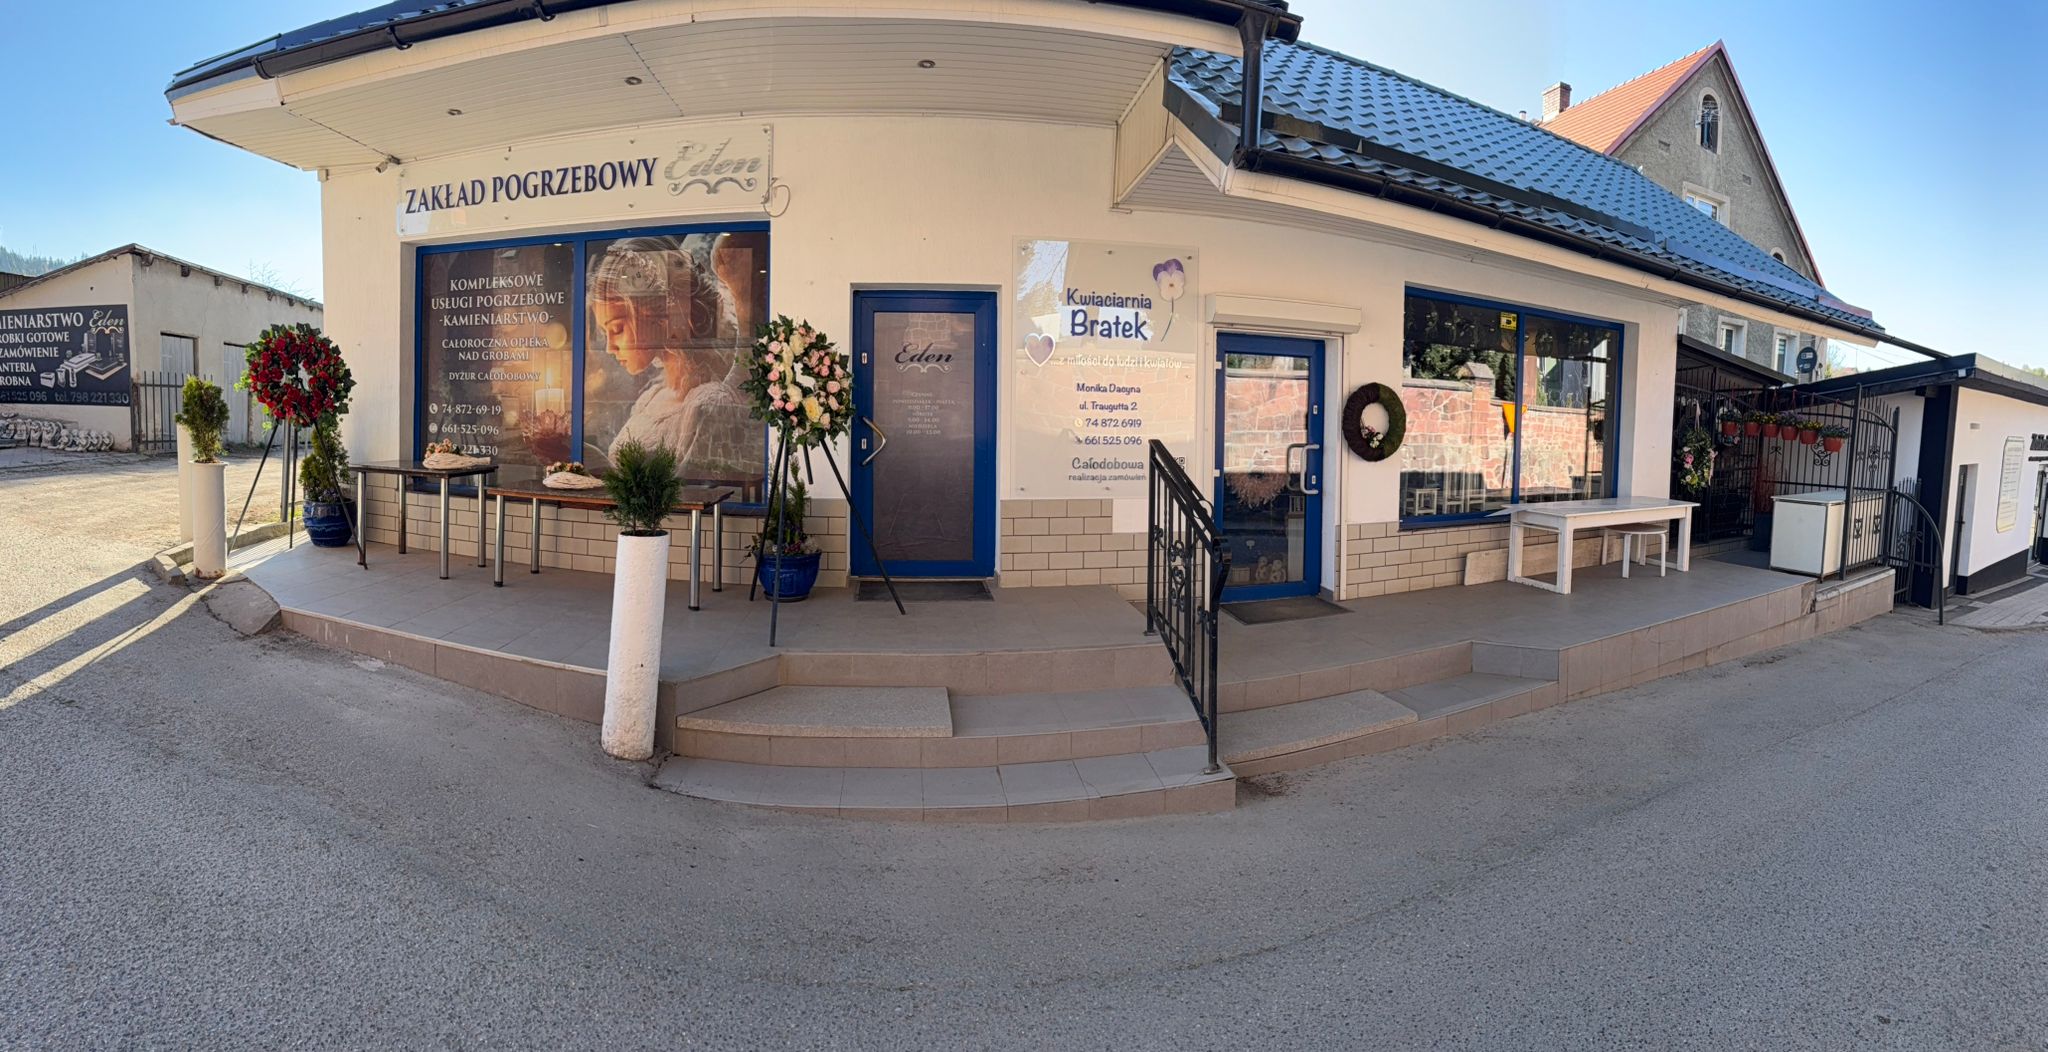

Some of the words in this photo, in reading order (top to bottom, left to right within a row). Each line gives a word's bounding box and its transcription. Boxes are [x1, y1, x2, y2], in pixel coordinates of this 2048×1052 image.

[664, 137, 762, 181] Eden
[405, 179, 485, 214] ZAKŁAD
[492, 158, 658, 203] POGRZEBOWY
[450, 274, 543, 291] KOMPLEKSOWE
[432, 296, 472, 310] USŁUGI
[476, 292, 565, 308] POGRZEBOWE
[1067, 288, 1152, 310] Kwiaciarnia
[0, 312, 83, 329] IENIARSTWO
[89, 309, 125, 328] Eden
[1071, 310, 1148, 341] Bratek
[27, 332, 69, 342] GOTOWE
[442, 338, 508, 349] CAŁOROCZNA
[510, 337, 549, 347] OPIEKA
[0, 345, 59, 358] ZAMÓWIENIE
[458, 352, 479, 361] NAD
[482, 351, 529, 360] GROBAMI
[895, 342, 954, 364] Eden
[1067, 353, 1100, 367] miłości
[1102, 356, 1115, 367] do
[1116, 355, 1138, 368] ludzi
[449, 371, 476, 381] DYŻUR
[478, 372, 540, 381] CAŁODOBOWY
[1077, 383, 1108, 393] Monika
[30, 391, 47, 402] 096
[71, 392, 88, 402] 798
[90, 393, 107, 403] 221
[109, 393, 129, 404] 330
[442, 404, 501, 415] 74-872-69-19
[1079, 401, 1088, 411] ul.
[1091, 401, 1129, 412] Traugutta
[1131, 402, 1138, 411] 2
[1085, 418, 1099, 428] 74
[1101, 418, 1120, 428] 872
[1122, 417, 1142, 428] 6919
[441, 425, 499, 435] 661-525-096
[1085, 436, 1101, 446] 661
[1102, 436, 1122, 445] 525
[1124, 436, 1142, 446] 096
[1072, 457, 1144, 470] Całodobowa
[1069, 473, 1107, 482] realizacja
